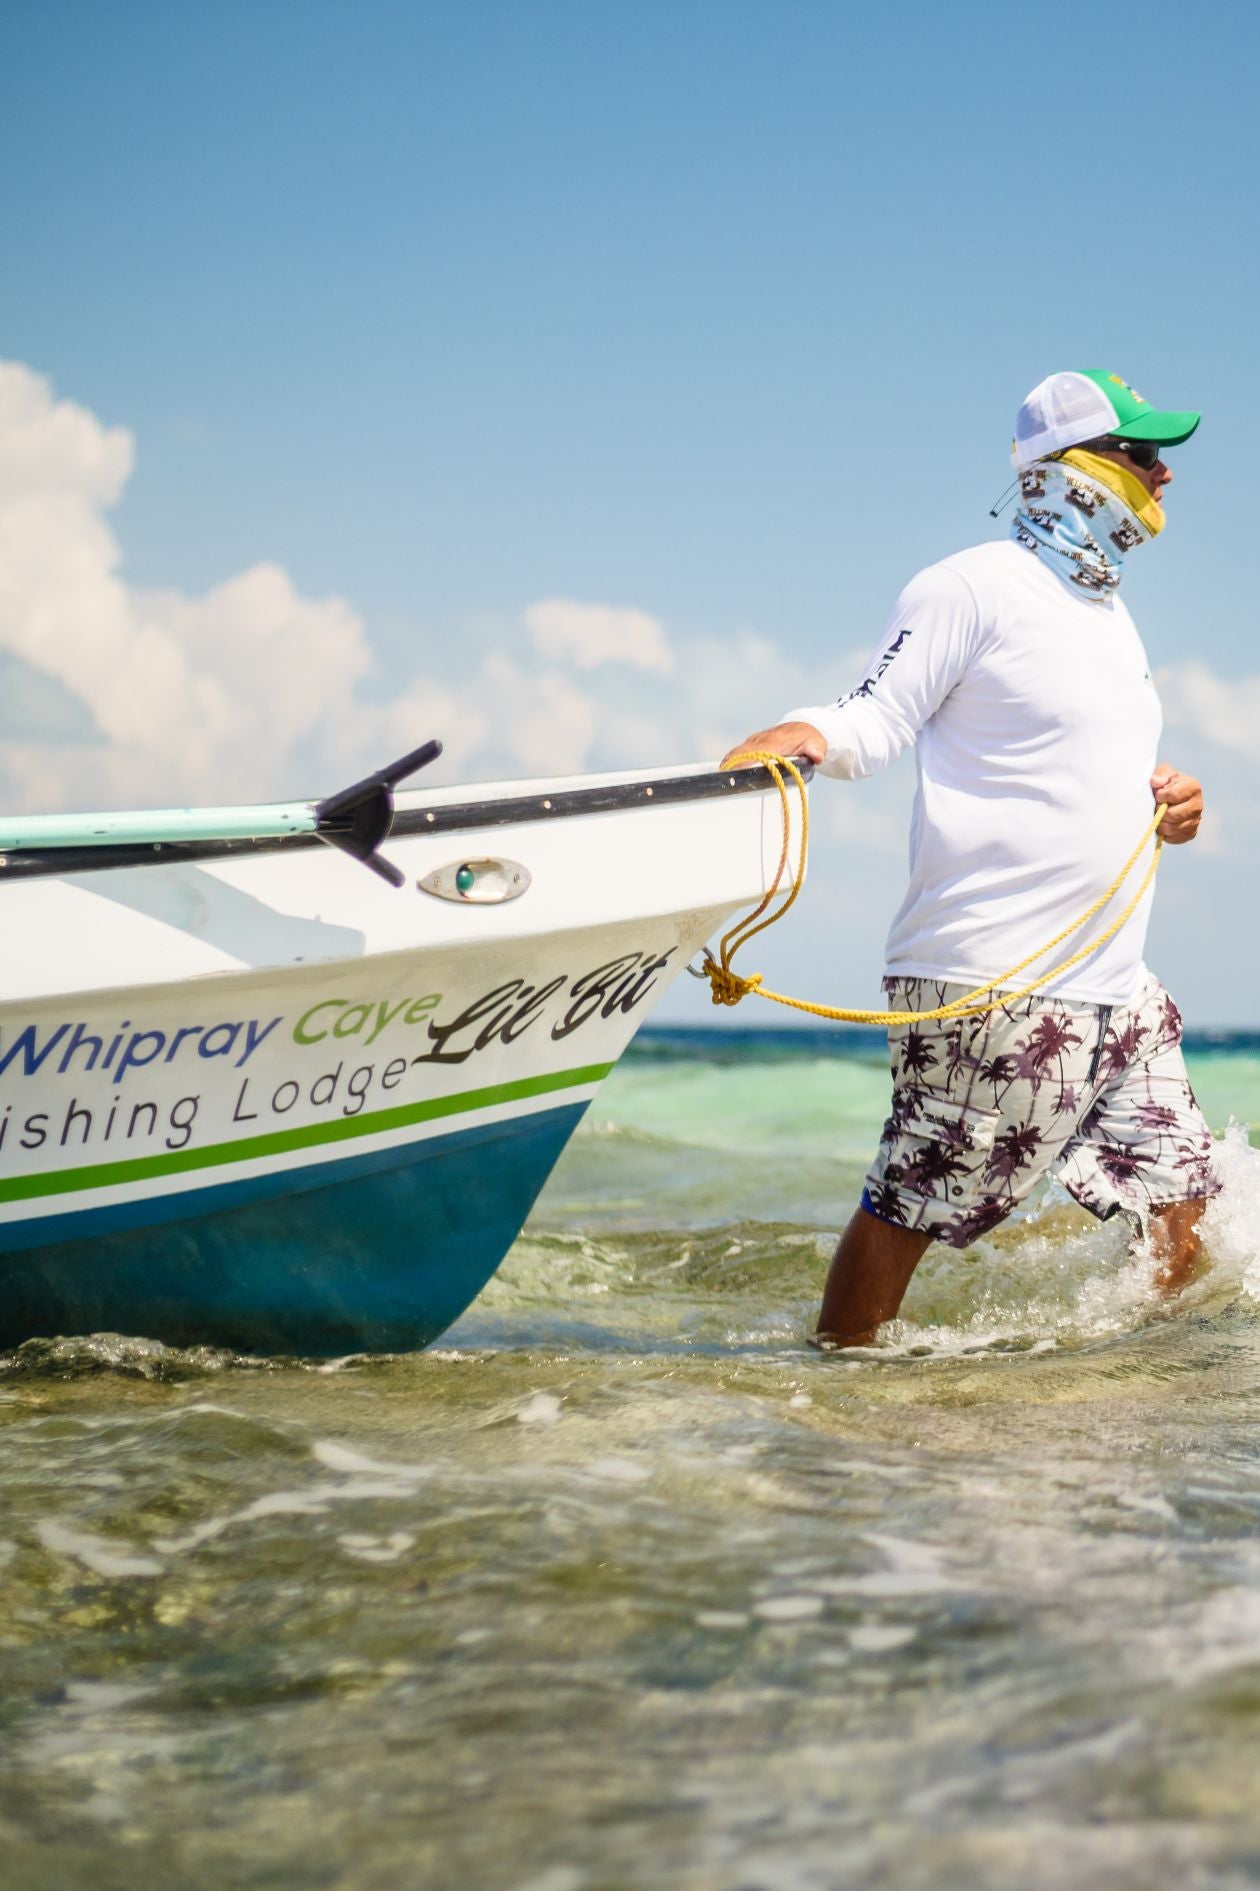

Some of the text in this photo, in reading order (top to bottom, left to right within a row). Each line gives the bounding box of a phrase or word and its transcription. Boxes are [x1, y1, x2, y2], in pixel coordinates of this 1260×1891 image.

[0, 992, 443, 1084] Whipray Caye
[551, 945, 678, 1041] Bit
[0, 1057, 407, 1149] ishing Lodge
